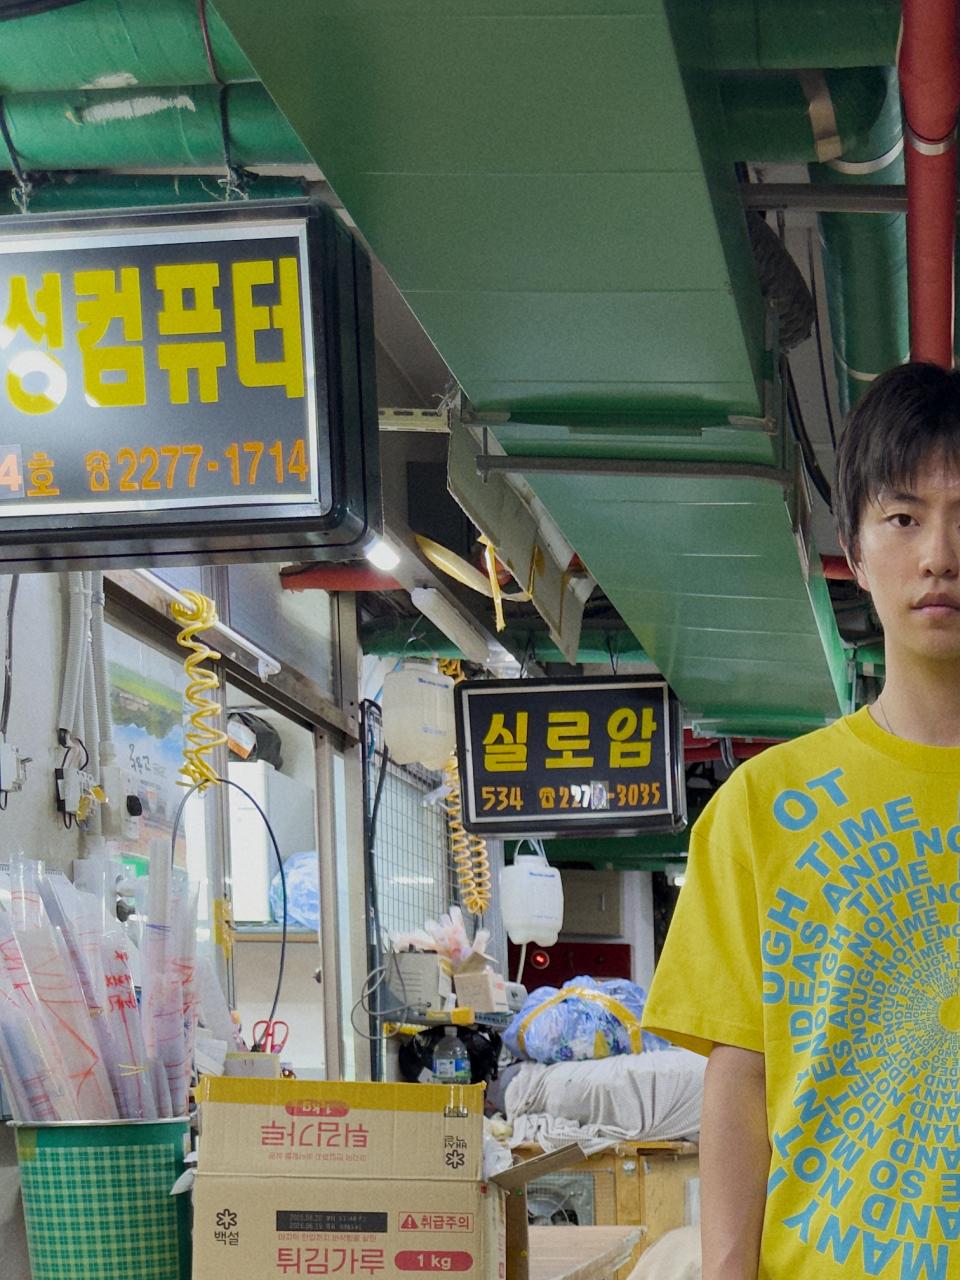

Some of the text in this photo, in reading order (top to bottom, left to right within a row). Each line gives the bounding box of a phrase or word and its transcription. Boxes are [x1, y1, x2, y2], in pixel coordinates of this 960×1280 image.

[0, 257, 305, 415] 성컴퓨터
[0, 439, 309, 497] 4호 2277-1714
[482, 707, 658, 773] 실로암
[482, 785, 524, 811] 534
[795, 796, 919, 877] TIME
[844, 859, 932, 916] TIME
[788, 920, 831, 1054] IDEAS
[821, 841, 900, 913] AND
[846, 900, 898, 958] NOT
[828, 963, 857, 1029] AND
[849, 949, 884, 1062] ENOUGH
[879, 907, 939, 949] TIME
[833, 1039, 888, 1120] IDEAS
[864, 1067, 905, 1107] NOT
[261, 1120, 369, 1149] 튀김가루
[791, 1066, 865, 1172] MANY
[825, 1091, 884, 1149] NOT
[910, 1099, 960, 1123] AND
[772, 1124, 854, 1209] NOT
[868, 1159, 926, 1200] SO
[214, 1231, 239, 1246] 백설
[420, 1215, 470, 1230] 취급주의
[276, 1248, 452, 1275] 튀김가루 1 kg
